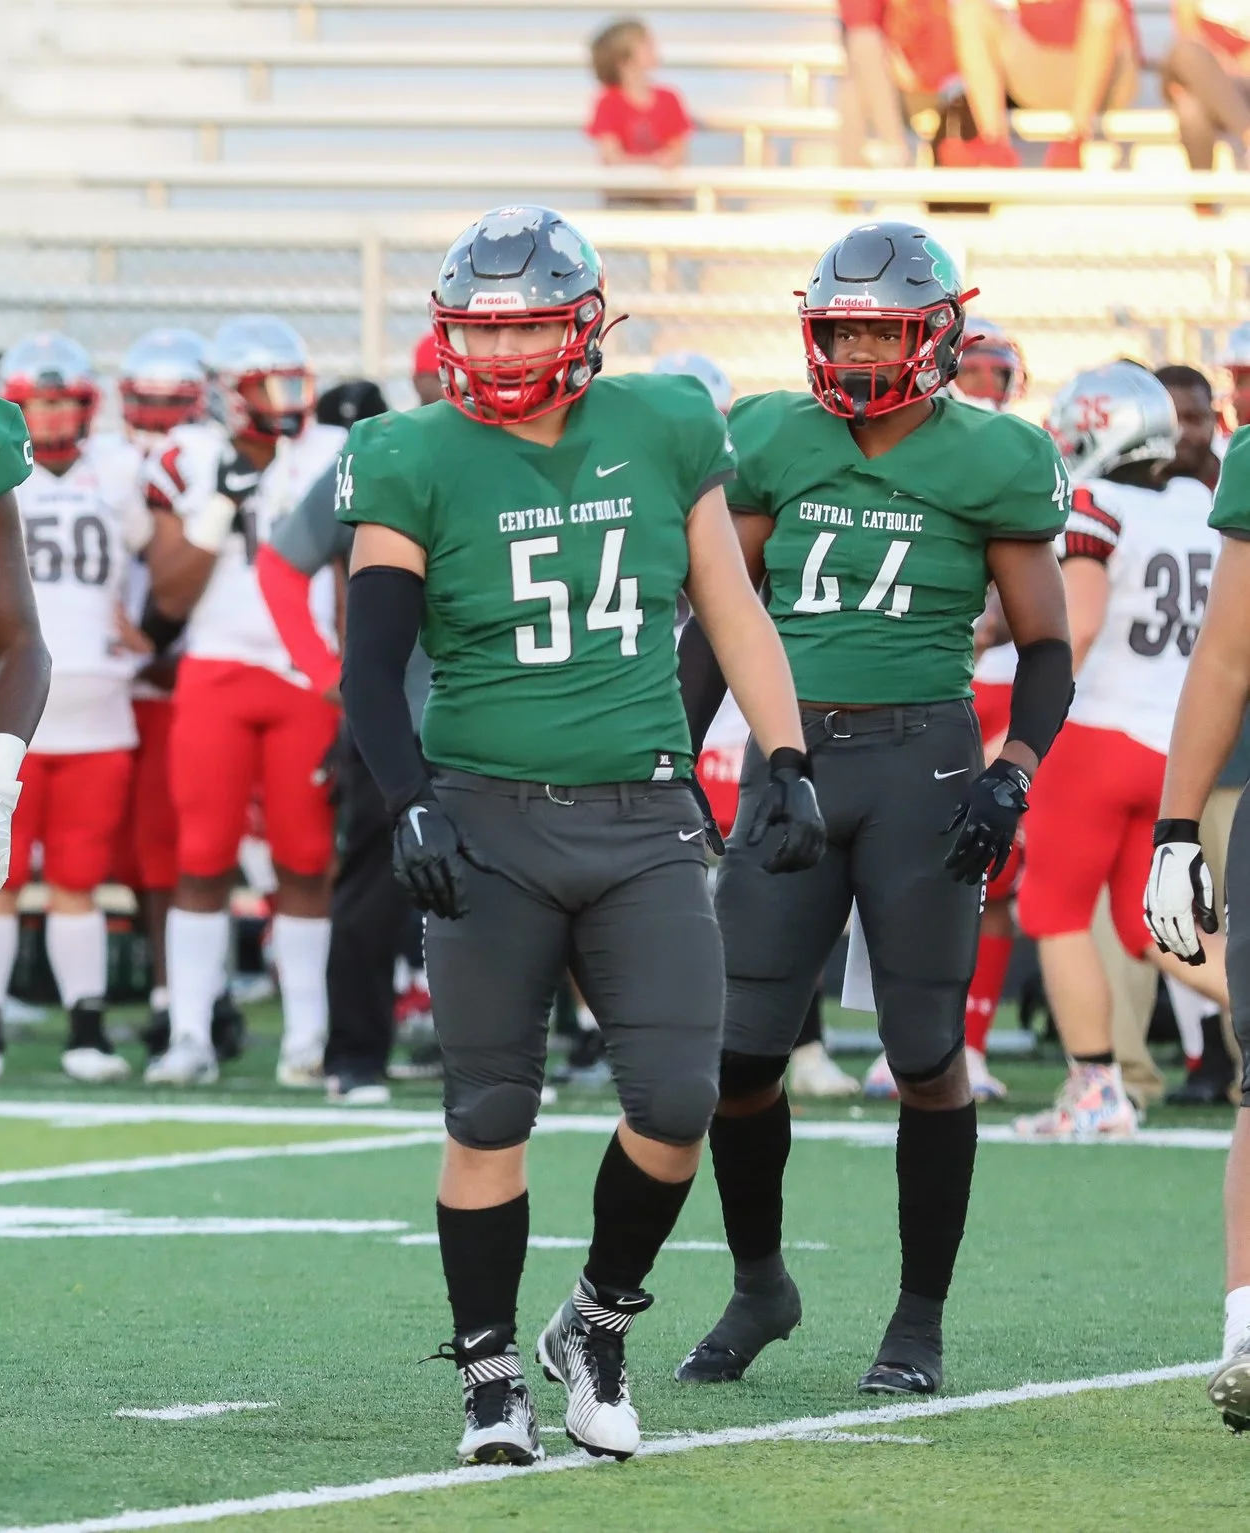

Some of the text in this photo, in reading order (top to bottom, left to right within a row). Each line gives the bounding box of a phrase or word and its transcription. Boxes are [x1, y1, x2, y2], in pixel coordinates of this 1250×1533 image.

[834, 297, 872, 308] Riddell
[1073, 394, 1111, 431] 35
[498, 497, 633, 533] CENTRAL CATHOLIC
[799, 501, 924, 533] CENTRAL CATHOLIC
[25, 515, 111, 586] 50
[792, 531, 913, 619] 44
[509, 527, 645, 665] 54
[1128, 552, 1212, 658] 35
[659, 754, 672, 765] XL
